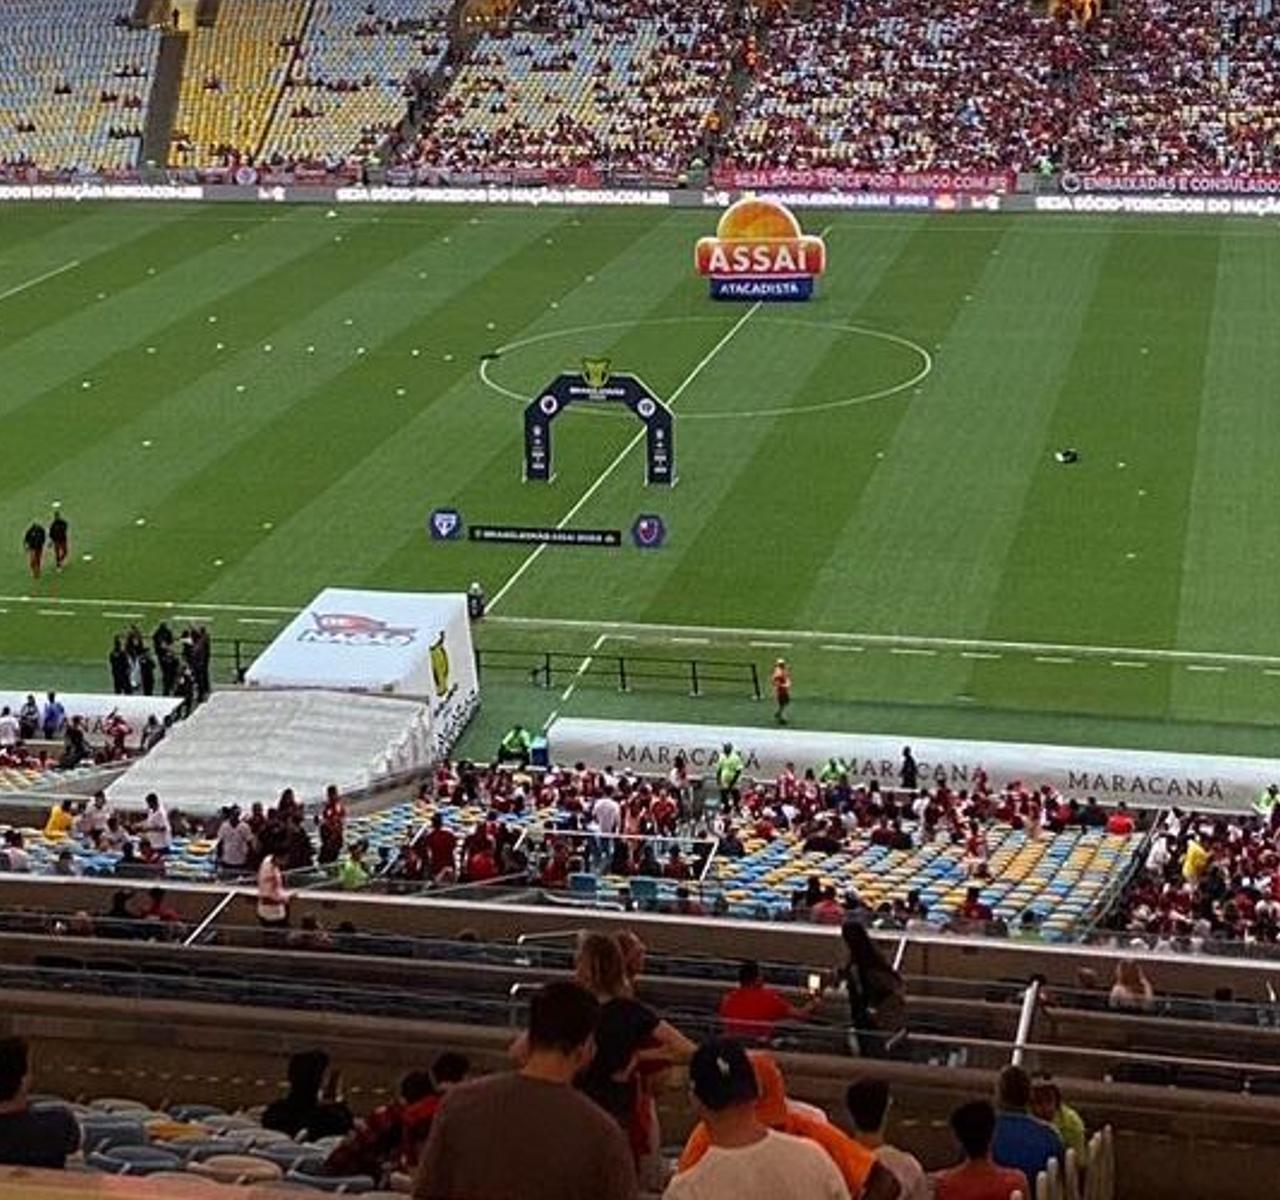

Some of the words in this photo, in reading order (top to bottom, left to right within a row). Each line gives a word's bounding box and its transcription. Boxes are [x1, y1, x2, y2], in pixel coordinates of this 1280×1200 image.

[32, 185, 53, 199] DO
[489, 188, 510, 202] DO
[1207, 198, 1231, 213] DO
[720, 283, 799, 294] ATACADISTA
